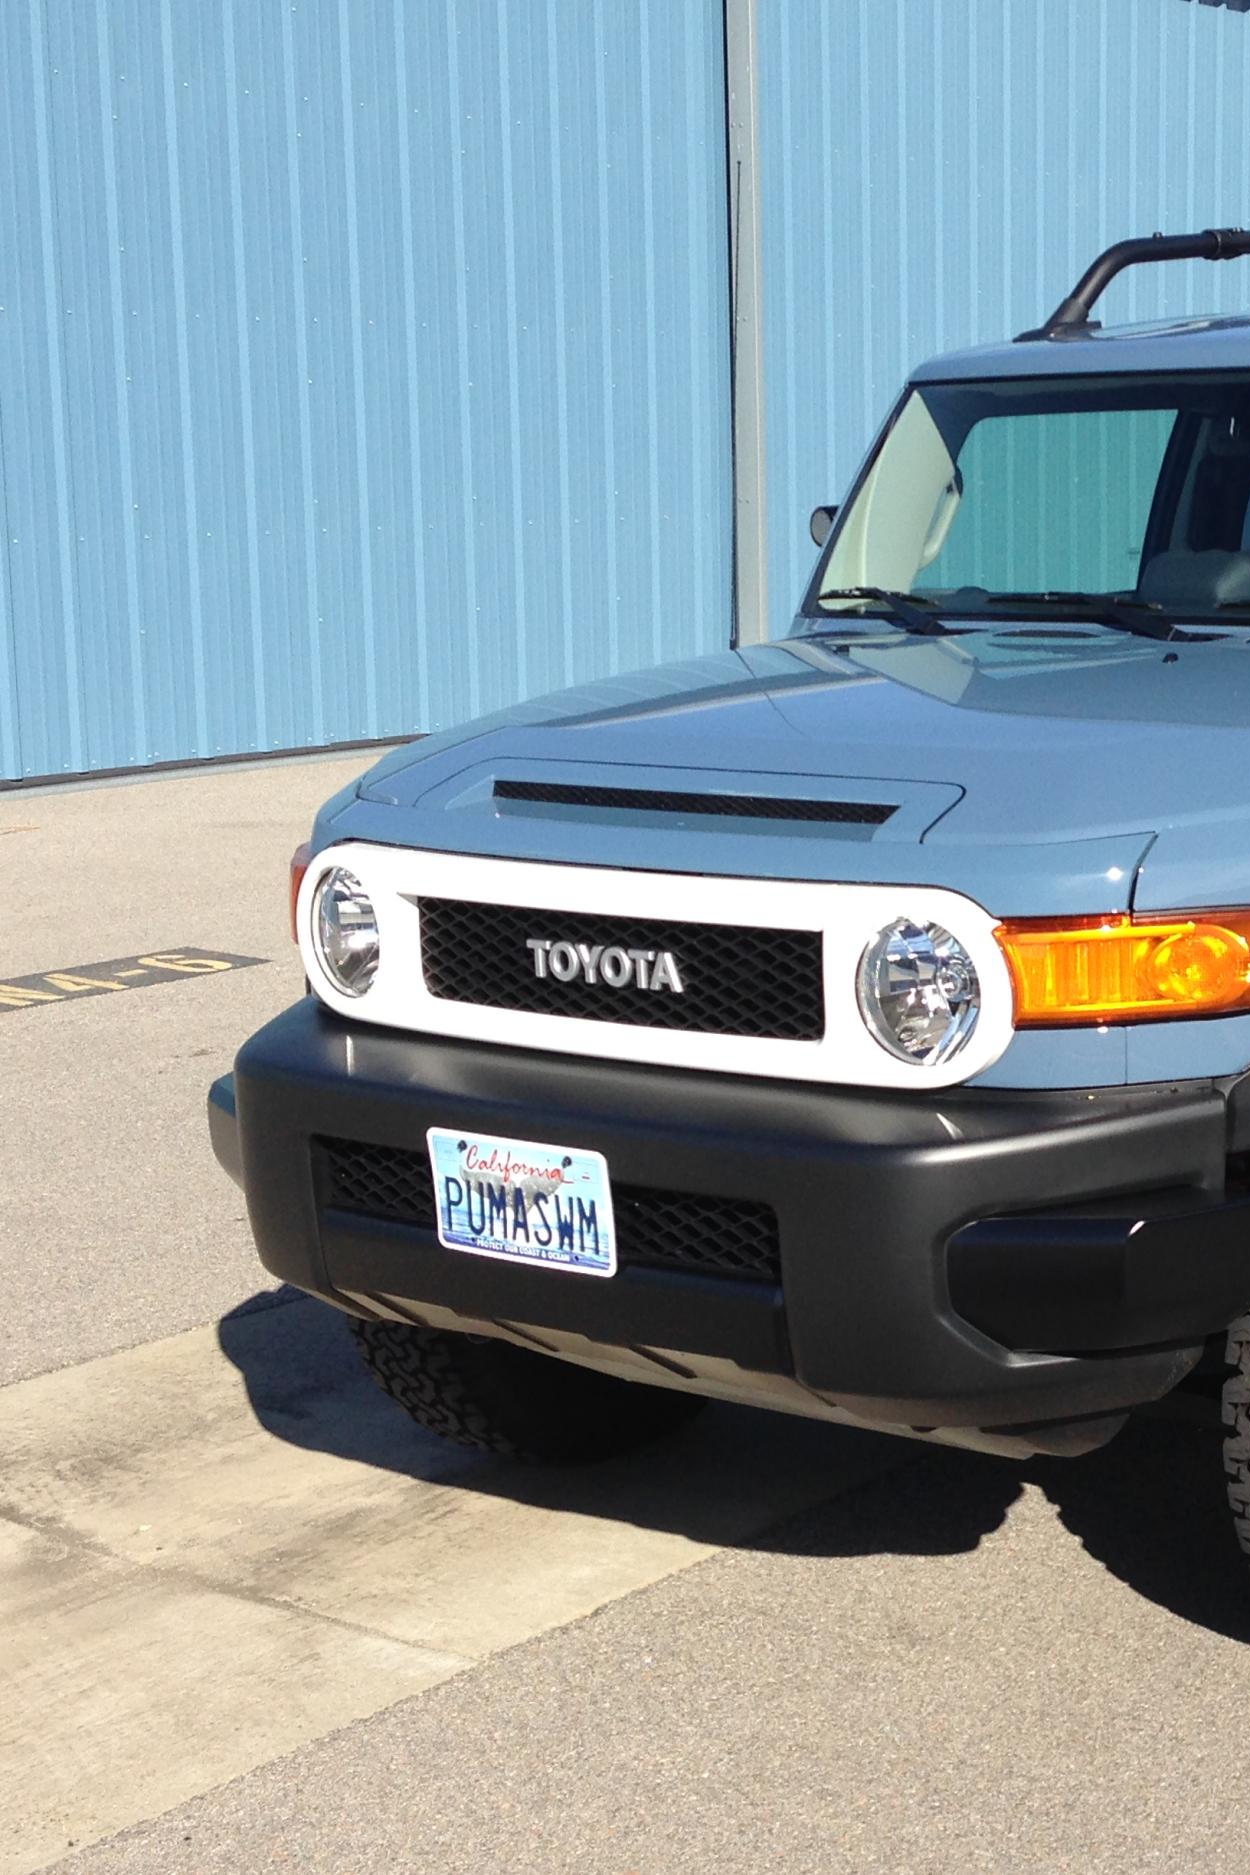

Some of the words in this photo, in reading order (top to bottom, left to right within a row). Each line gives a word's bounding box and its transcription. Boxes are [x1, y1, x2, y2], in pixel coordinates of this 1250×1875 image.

[525, 938, 685, 993] TOYOTA
[466, 1144, 574, 1184] California
[444, 1175, 600, 1256] PUMASWM
